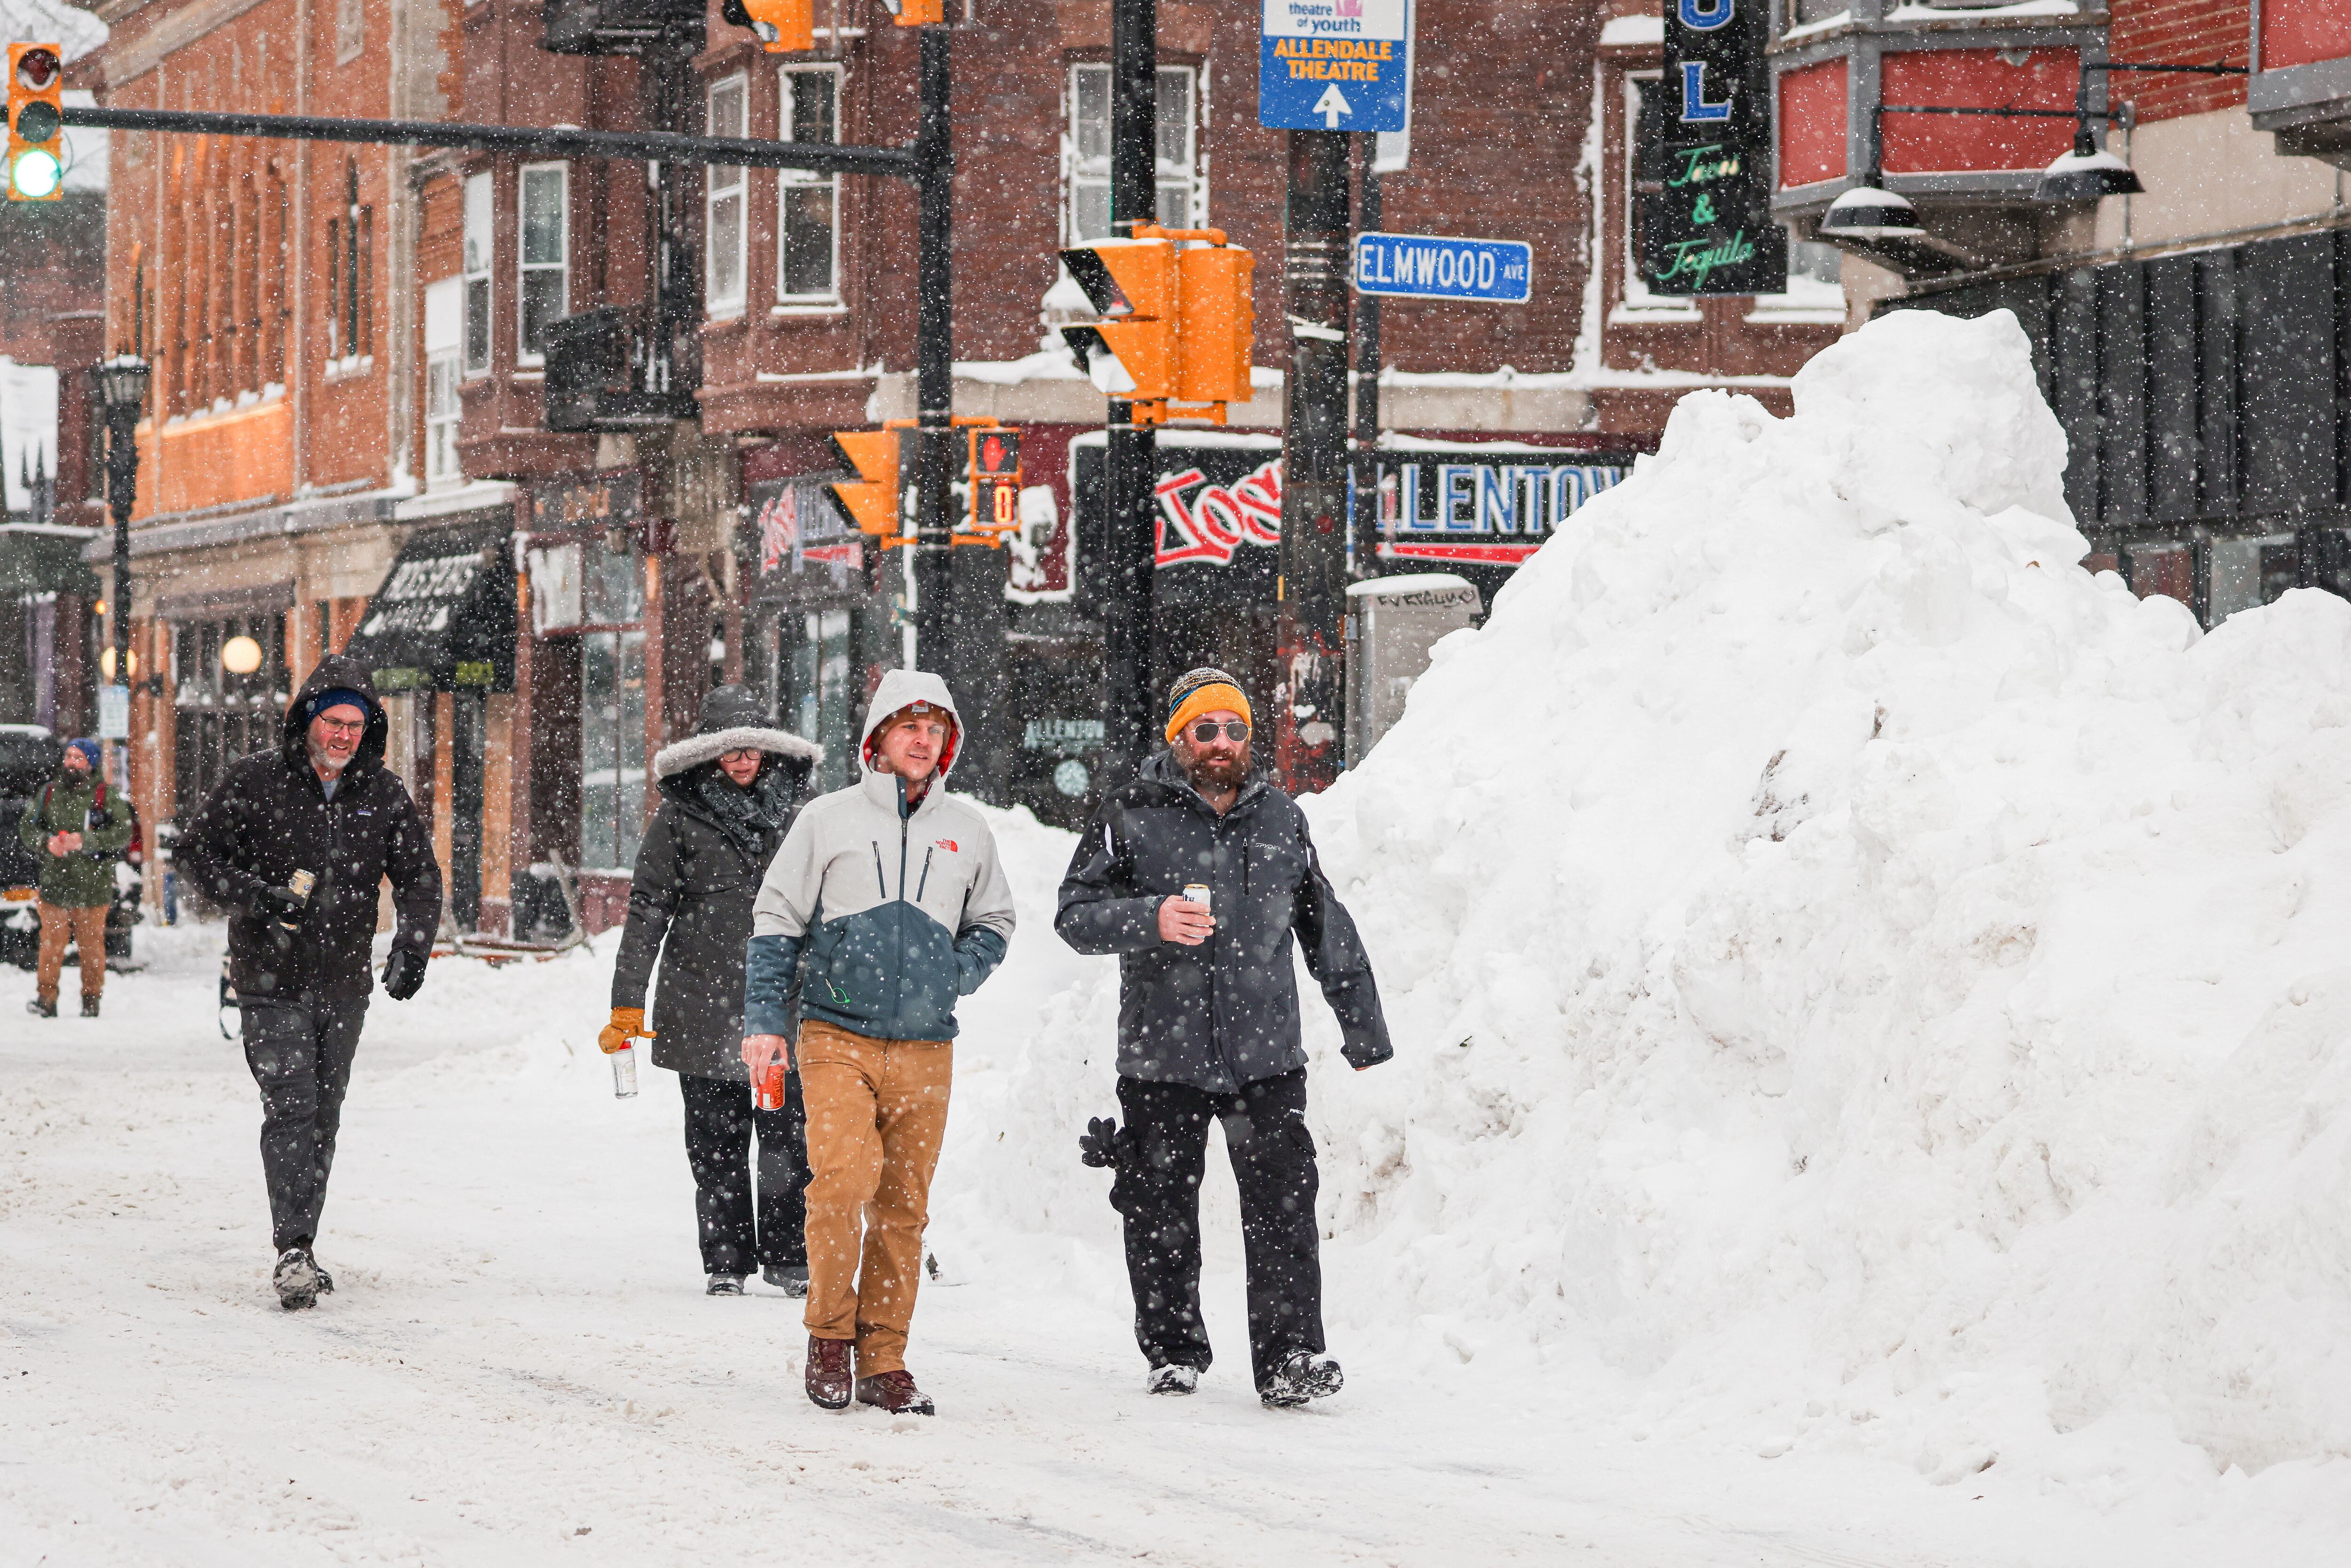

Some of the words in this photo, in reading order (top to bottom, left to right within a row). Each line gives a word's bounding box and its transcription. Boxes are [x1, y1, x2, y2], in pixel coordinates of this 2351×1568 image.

[1288, 2, 1333, 16] theatre
[1297, 17, 1308, 27] of
[1311, 18, 1362, 34] youth
[1273, 39, 1393, 61] ALLENDALE
[1286, 59, 1379, 81] THEATRE
[1692, 193, 1716, 224] &
[1359, 244, 1495, 290] ELMWOOD
[1502, 264, 1525, 281] AVE
[1655, 229, 1754, 290] Tequila
[1255, 843, 1281, 851] SPYDER
